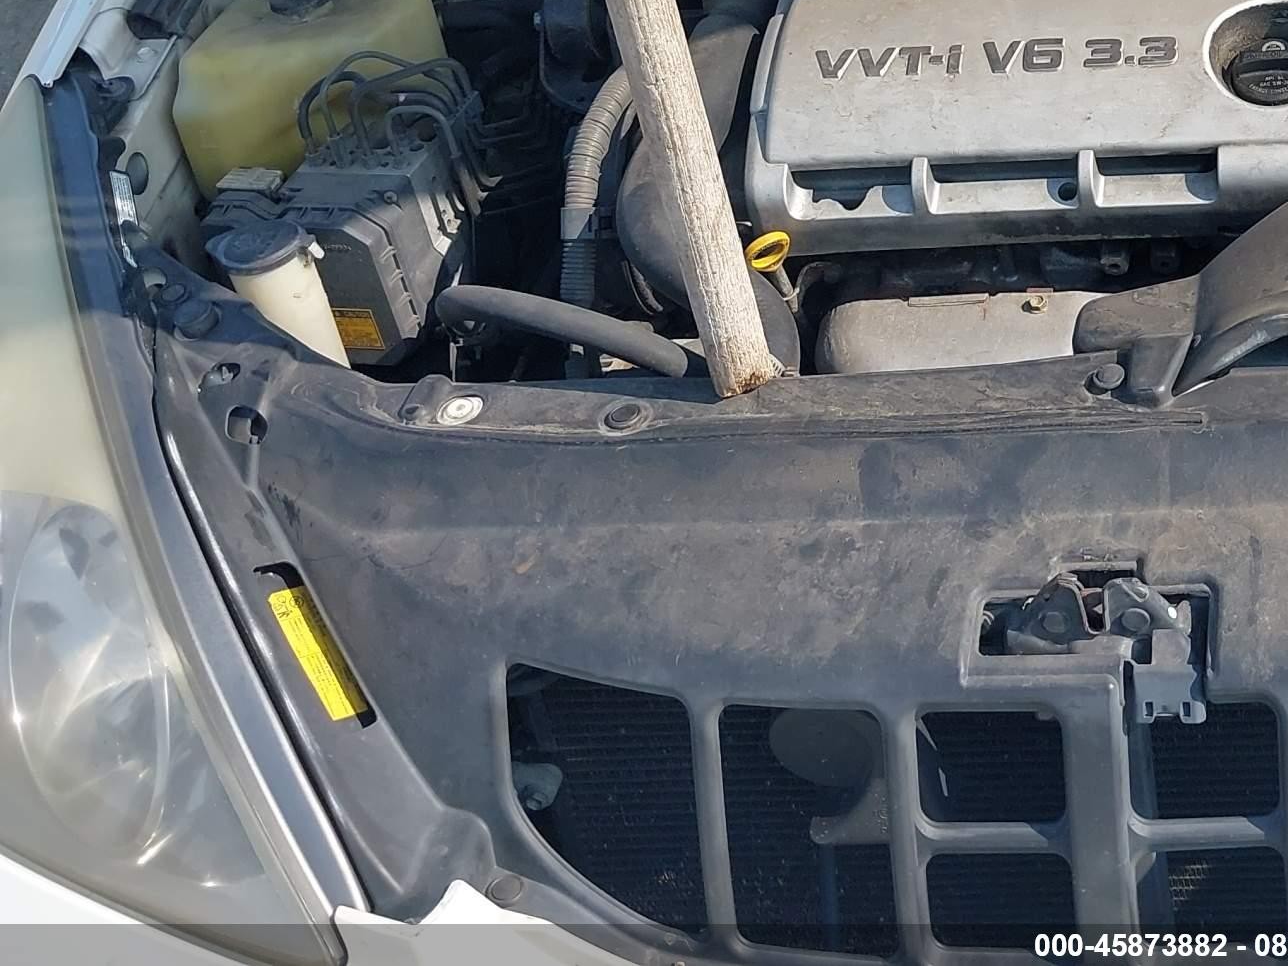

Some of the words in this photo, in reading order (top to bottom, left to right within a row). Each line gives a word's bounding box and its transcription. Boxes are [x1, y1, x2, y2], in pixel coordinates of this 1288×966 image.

[814, 44, 964, 80] VVT-i
[982, 38, 1065, 77] V6
[1082, 36, 1179, 70] 3.3
